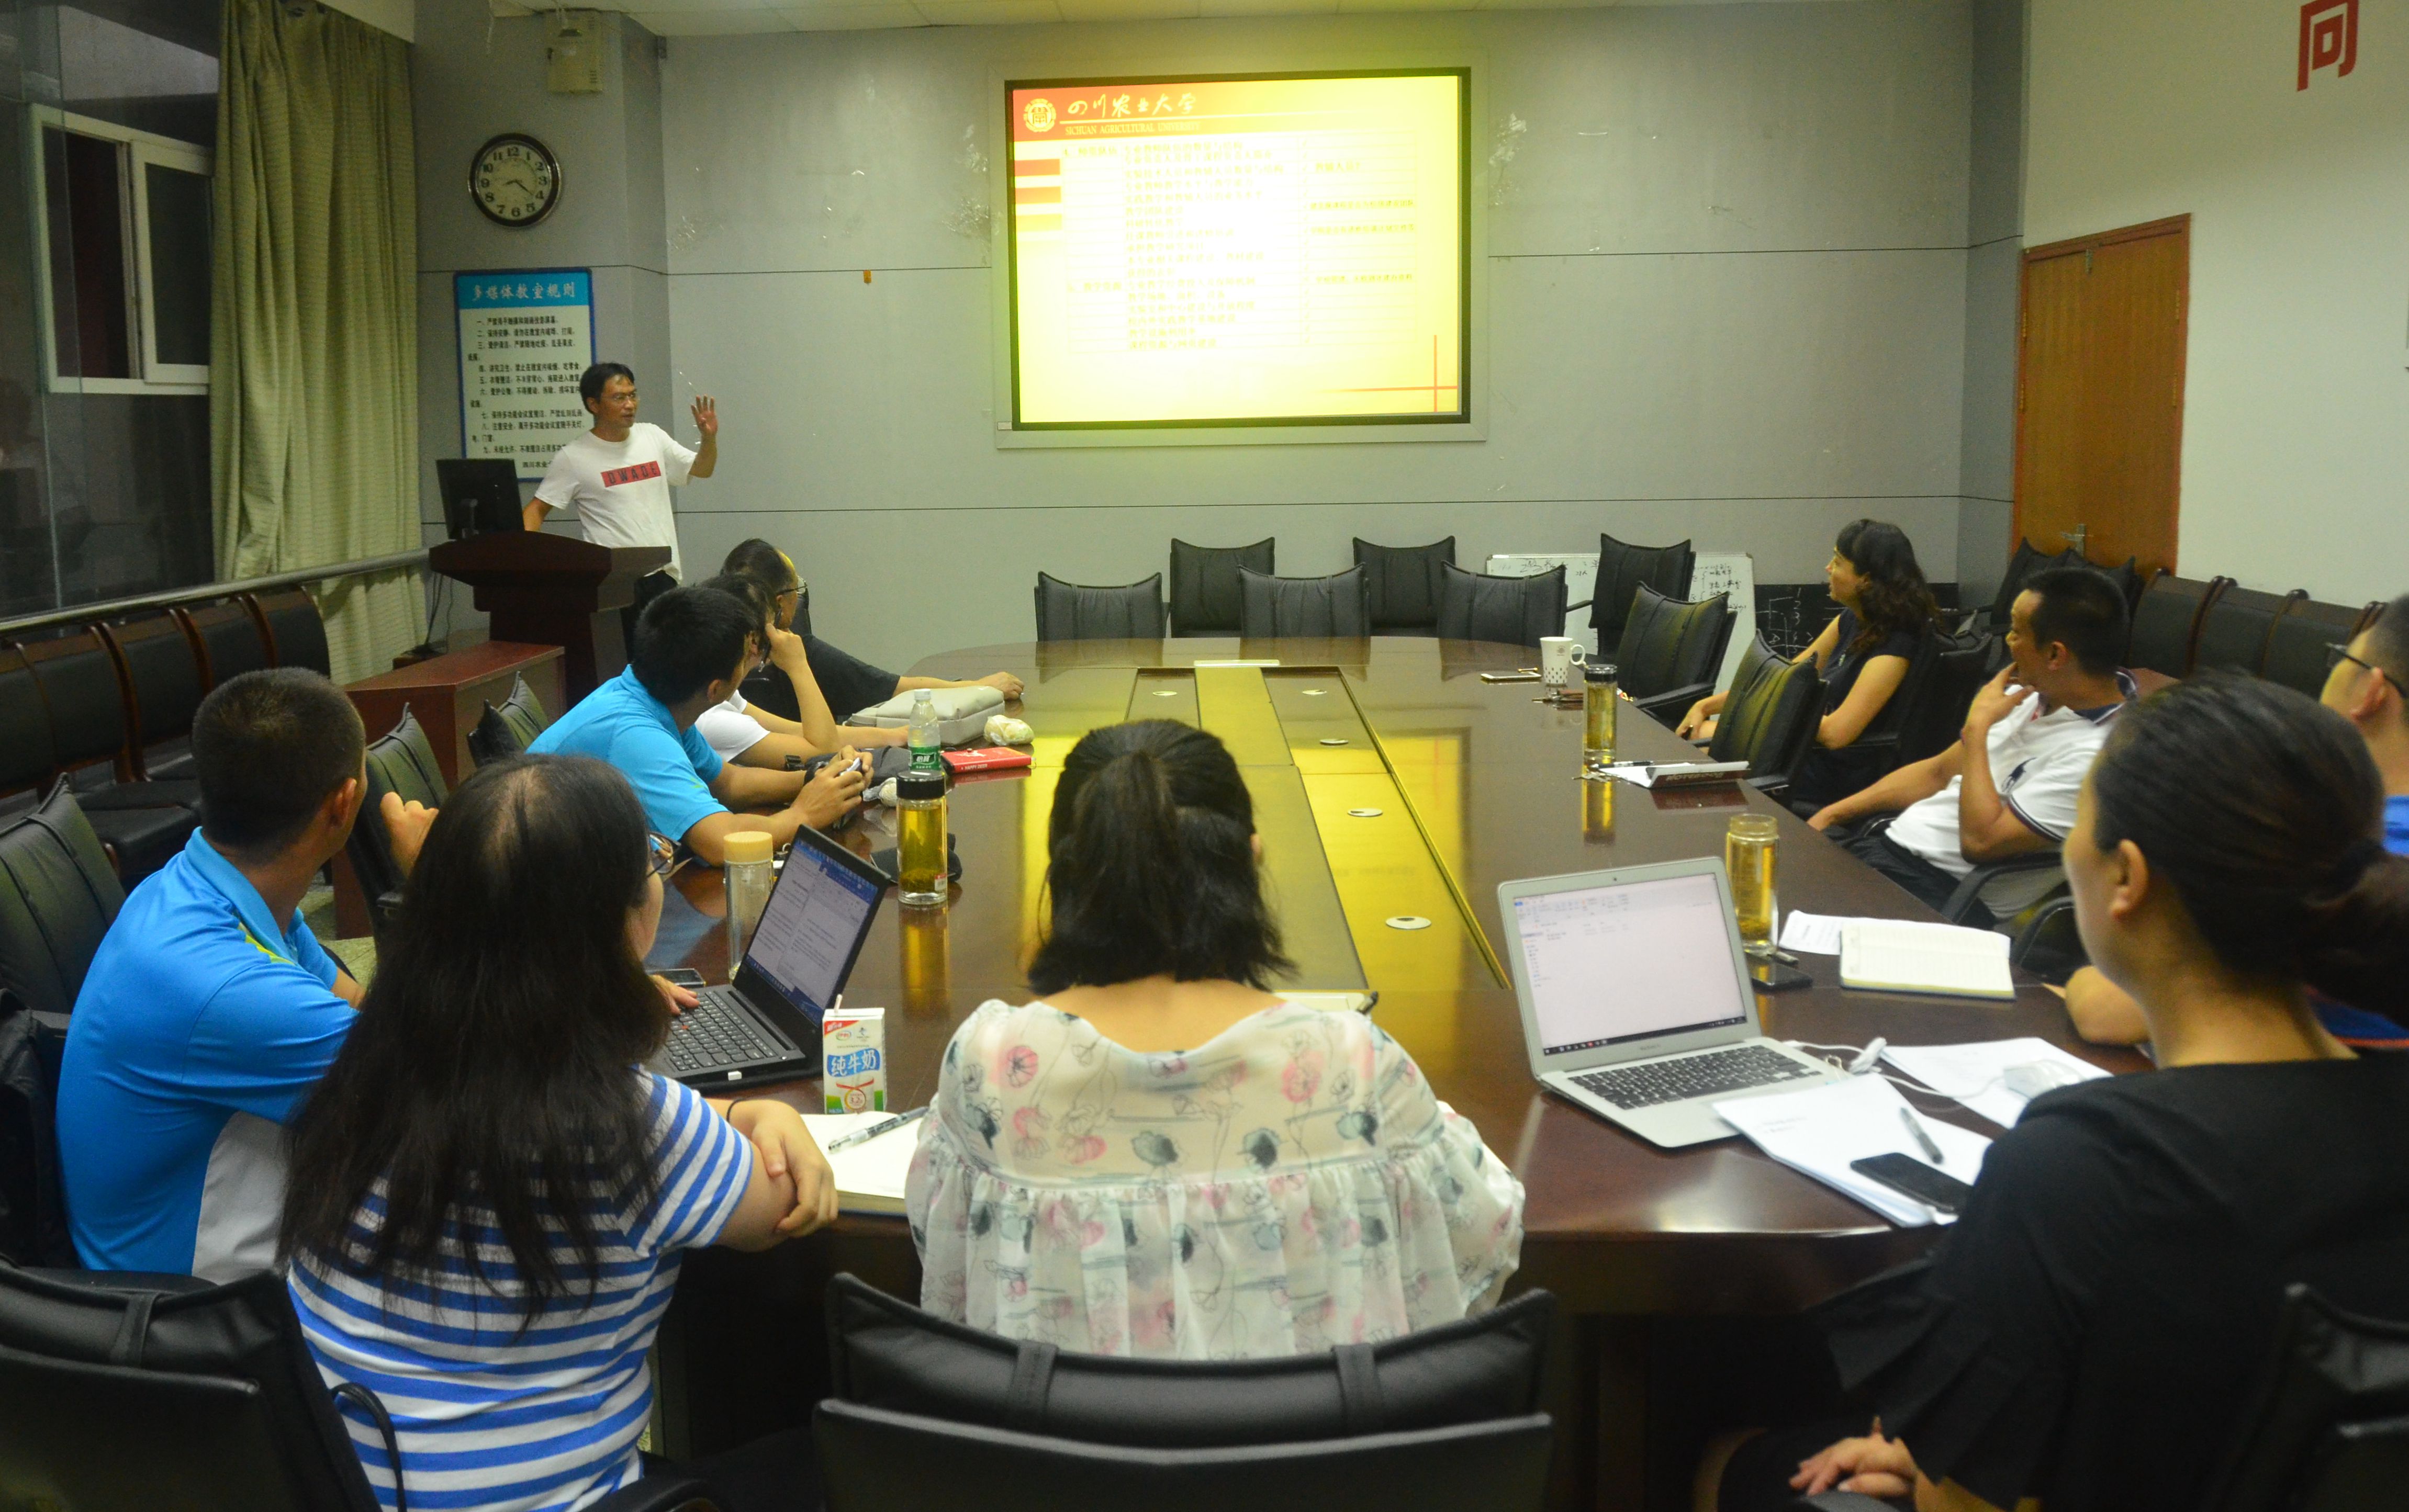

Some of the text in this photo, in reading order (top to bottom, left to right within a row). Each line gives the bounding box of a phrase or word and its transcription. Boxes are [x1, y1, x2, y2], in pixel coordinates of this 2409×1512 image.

[1067, 92, 1196, 119] 四川农业大学
[1065, 121, 1201, 136] SICHUAN AGRICULTURAL UNIVERSITY
[493, 152, 503, 160] 11
[507, 147, 520, 156] 12
[526, 152, 531, 160] 1
[535, 162, 544, 171] 2
[480, 178, 490, 188] 9
[538, 176, 548, 185] 3
[485, 193, 495, 202] 8
[535, 190, 545, 200] 4
[496, 205, 506, 214] 7
[511, 207, 521, 217] 6
[526, 203, 535, 212] 5
[472, 281, 576, 302] 多媒体教室规则
[522, 460, 552, 468] 四川农业
[831, 1049, 877, 1077] 纯牛奶
